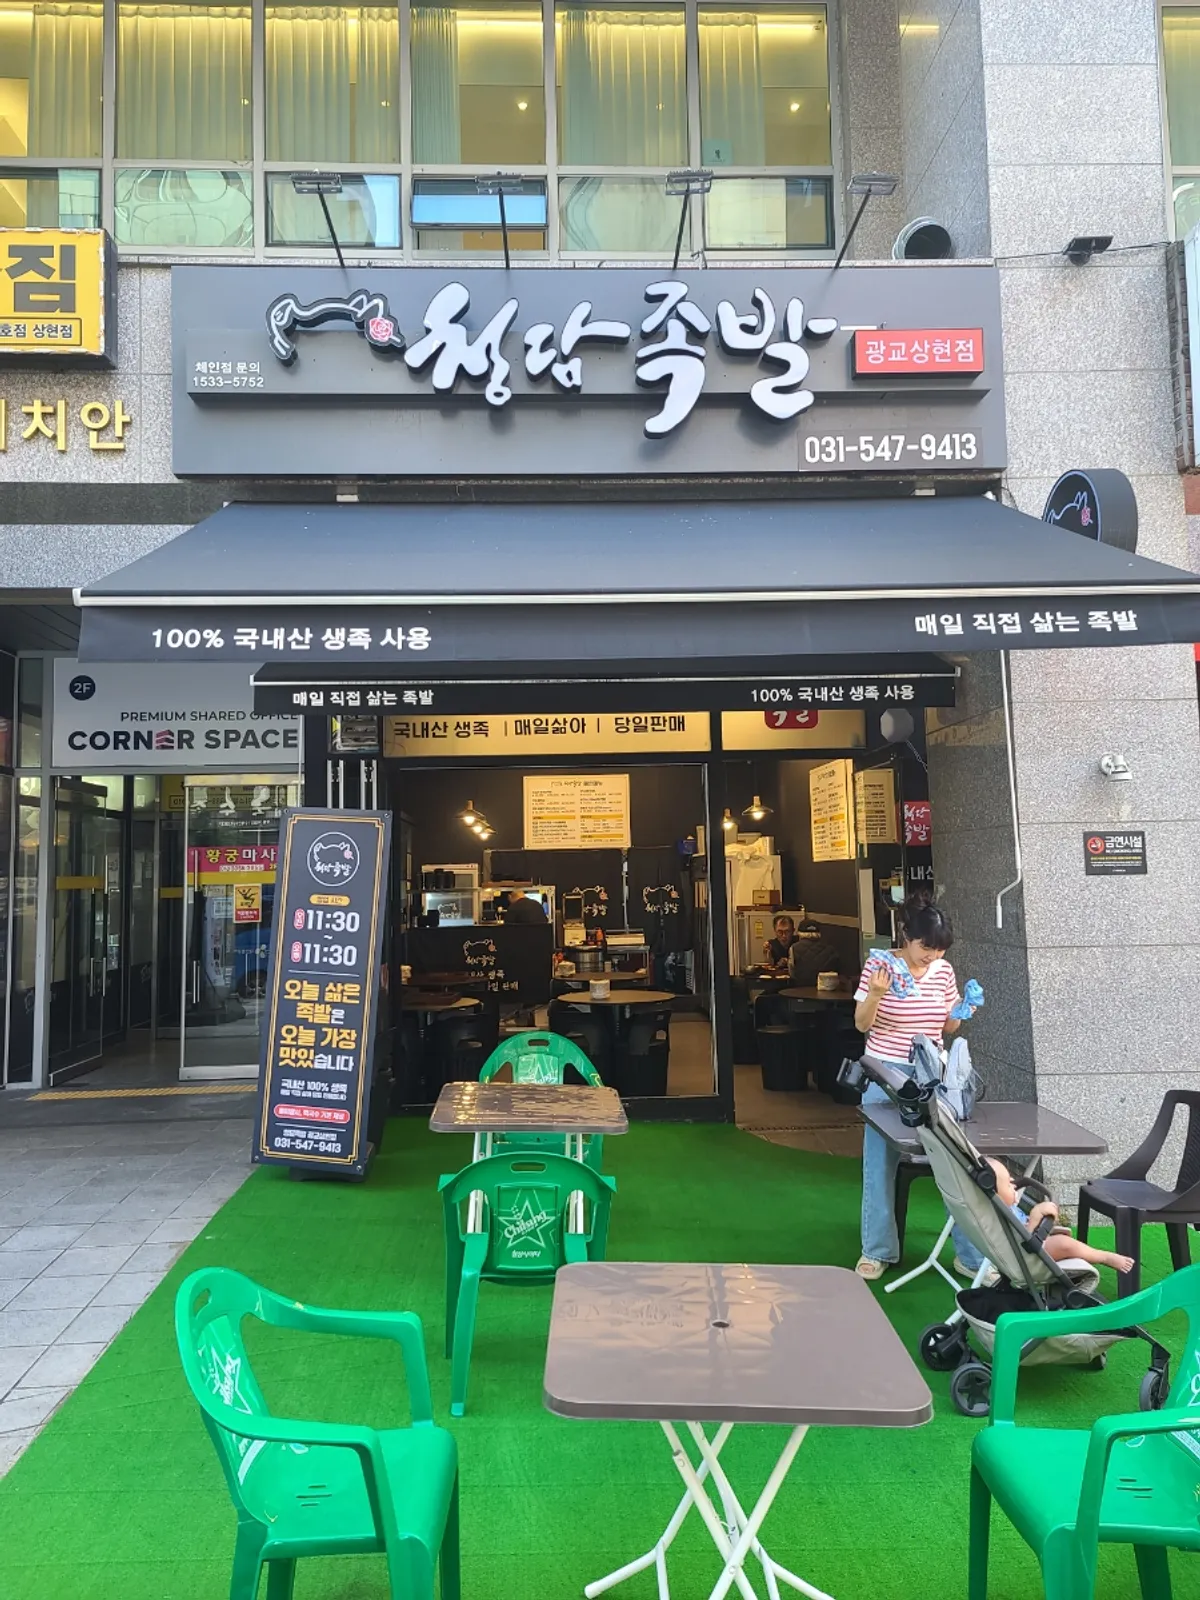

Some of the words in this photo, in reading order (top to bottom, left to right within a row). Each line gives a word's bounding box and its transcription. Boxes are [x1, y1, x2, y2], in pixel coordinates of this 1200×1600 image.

[33, 324, 72, 338] 상현점
[404, 281, 838, 438] 청담족발
[865, 338, 975, 364] 광교상현점
[195, 361, 232, 375] 체인점
[236, 361, 261, 375] 문의
[192, 377, 264, 388] 1533-5752
[0, 399, 131, 451] 치안
[804, 432, 977, 463] 031-547-9413
[915, 613, 965, 635] 매일
[972, 612, 1022, 634] 직접
[1029, 611, 1080, 633] 삶는
[1087, 610, 1138, 632] 족발
[151, 628, 224, 649] 100%
[233, 627, 313, 650] 국내산
[321, 627, 371, 650] 생족
[380, 627, 432, 650] 사용
[73, 683, 92, 693] 2F
[292, 691, 325, 707] 매일
[330, 690, 360, 706] 직접
[366, 690, 398, 706] 삶는
[402, 689, 434, 705] 족발
[751, 688, 793, 702] 100%
[797, 686, 844, 702] 국내산
[849, 685, 880, 701] 생족
[884, 684, 915, 700] 사용
[120, 711, 186, 722] PREMIUM
[190, 711, 246, 721] SHARED
[393, 721, 448, 738] 국내산
[454, 720, 490, 737] 생족
[613, 715, 686, 734] 당일판매
[68, 728, 195, 750] CORNER
[205, 729, 298, 749] SPACE
[1105, 836, 1142, 848] 금연시설
[307, 910, 360, 932] 11:30
[304, 943, 357, 966] 11:30
[284, 980, 320, 1001] 오늘
[325, 982, 360, 1004] 삶은
[296, 1003, 345, 1024] 족발은
[280, 1025, 316, 1046] 오늘
[320, 1027, 357, 1049] 가장
[278, 1047, 354, 1071] 맛있습니다
[281, 1079, 305, 1090] 국내산
[307, 1081, 329, 1092] 100%
[274, 1137, 341, 1153] 031-547-9413
